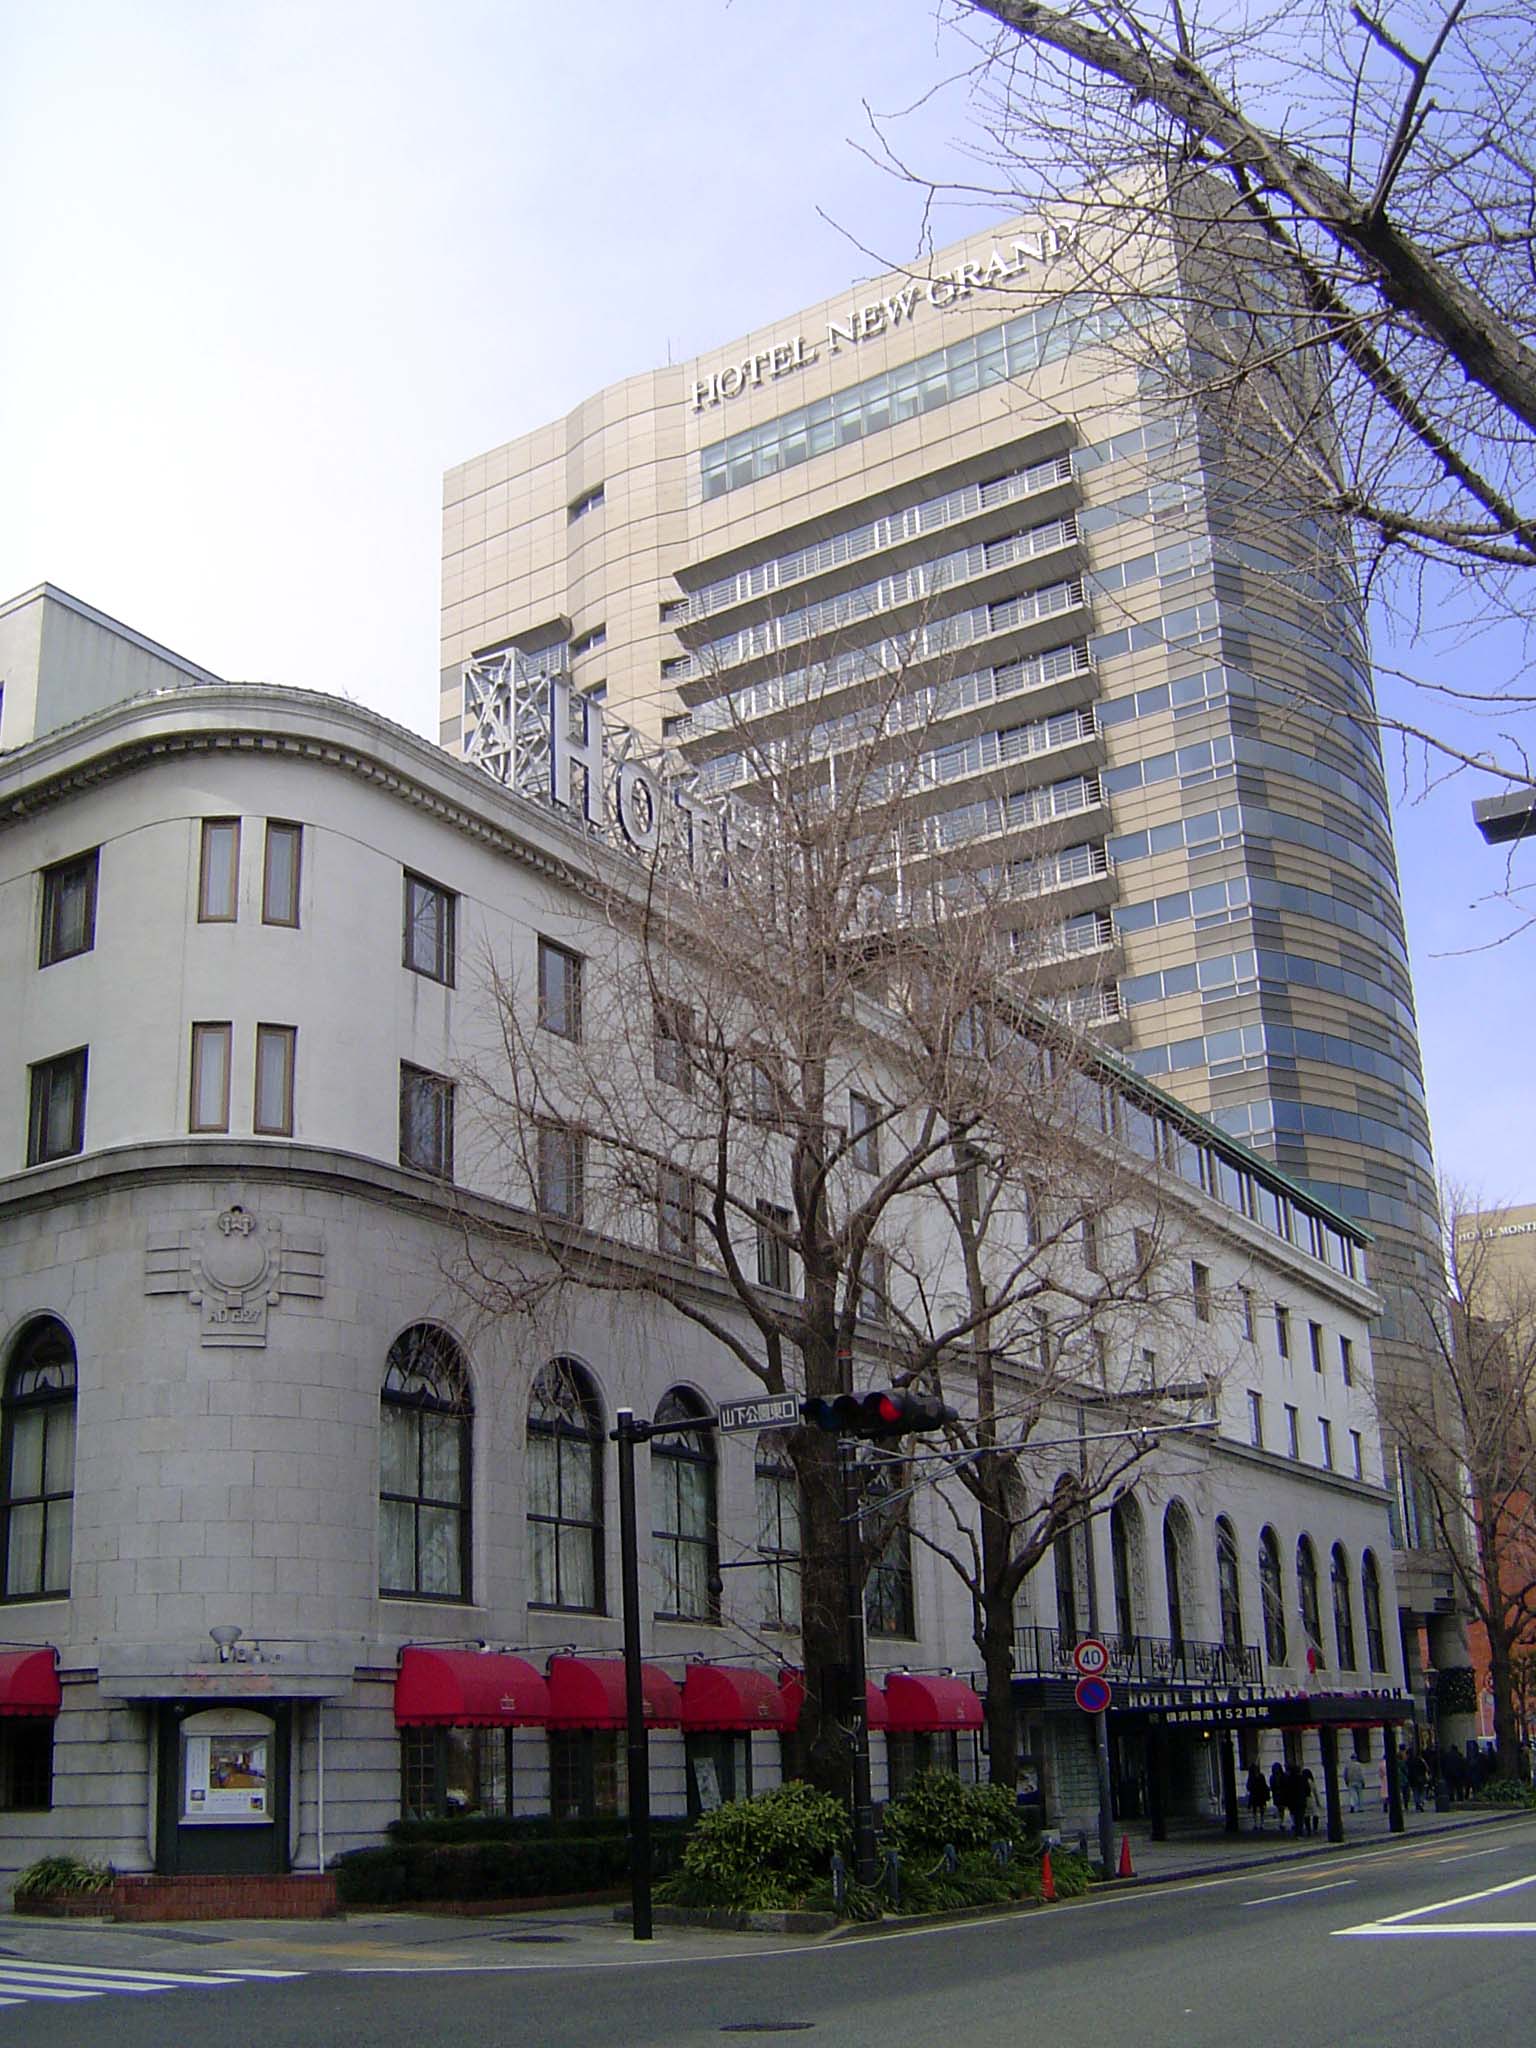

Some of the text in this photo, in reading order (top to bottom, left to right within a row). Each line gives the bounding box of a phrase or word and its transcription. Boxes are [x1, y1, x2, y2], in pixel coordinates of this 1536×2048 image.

[689, 336, 820, 411] HOTEL
[826, 285, 921, 353] NEW
[1459, 1228, 1496, 1241] HOEL
[1082, 1650, 1101, 1665] 40
[1128, 1691, 1182, 1707] HOTEL
[1191, 1688, 1230, 1703] NEW
